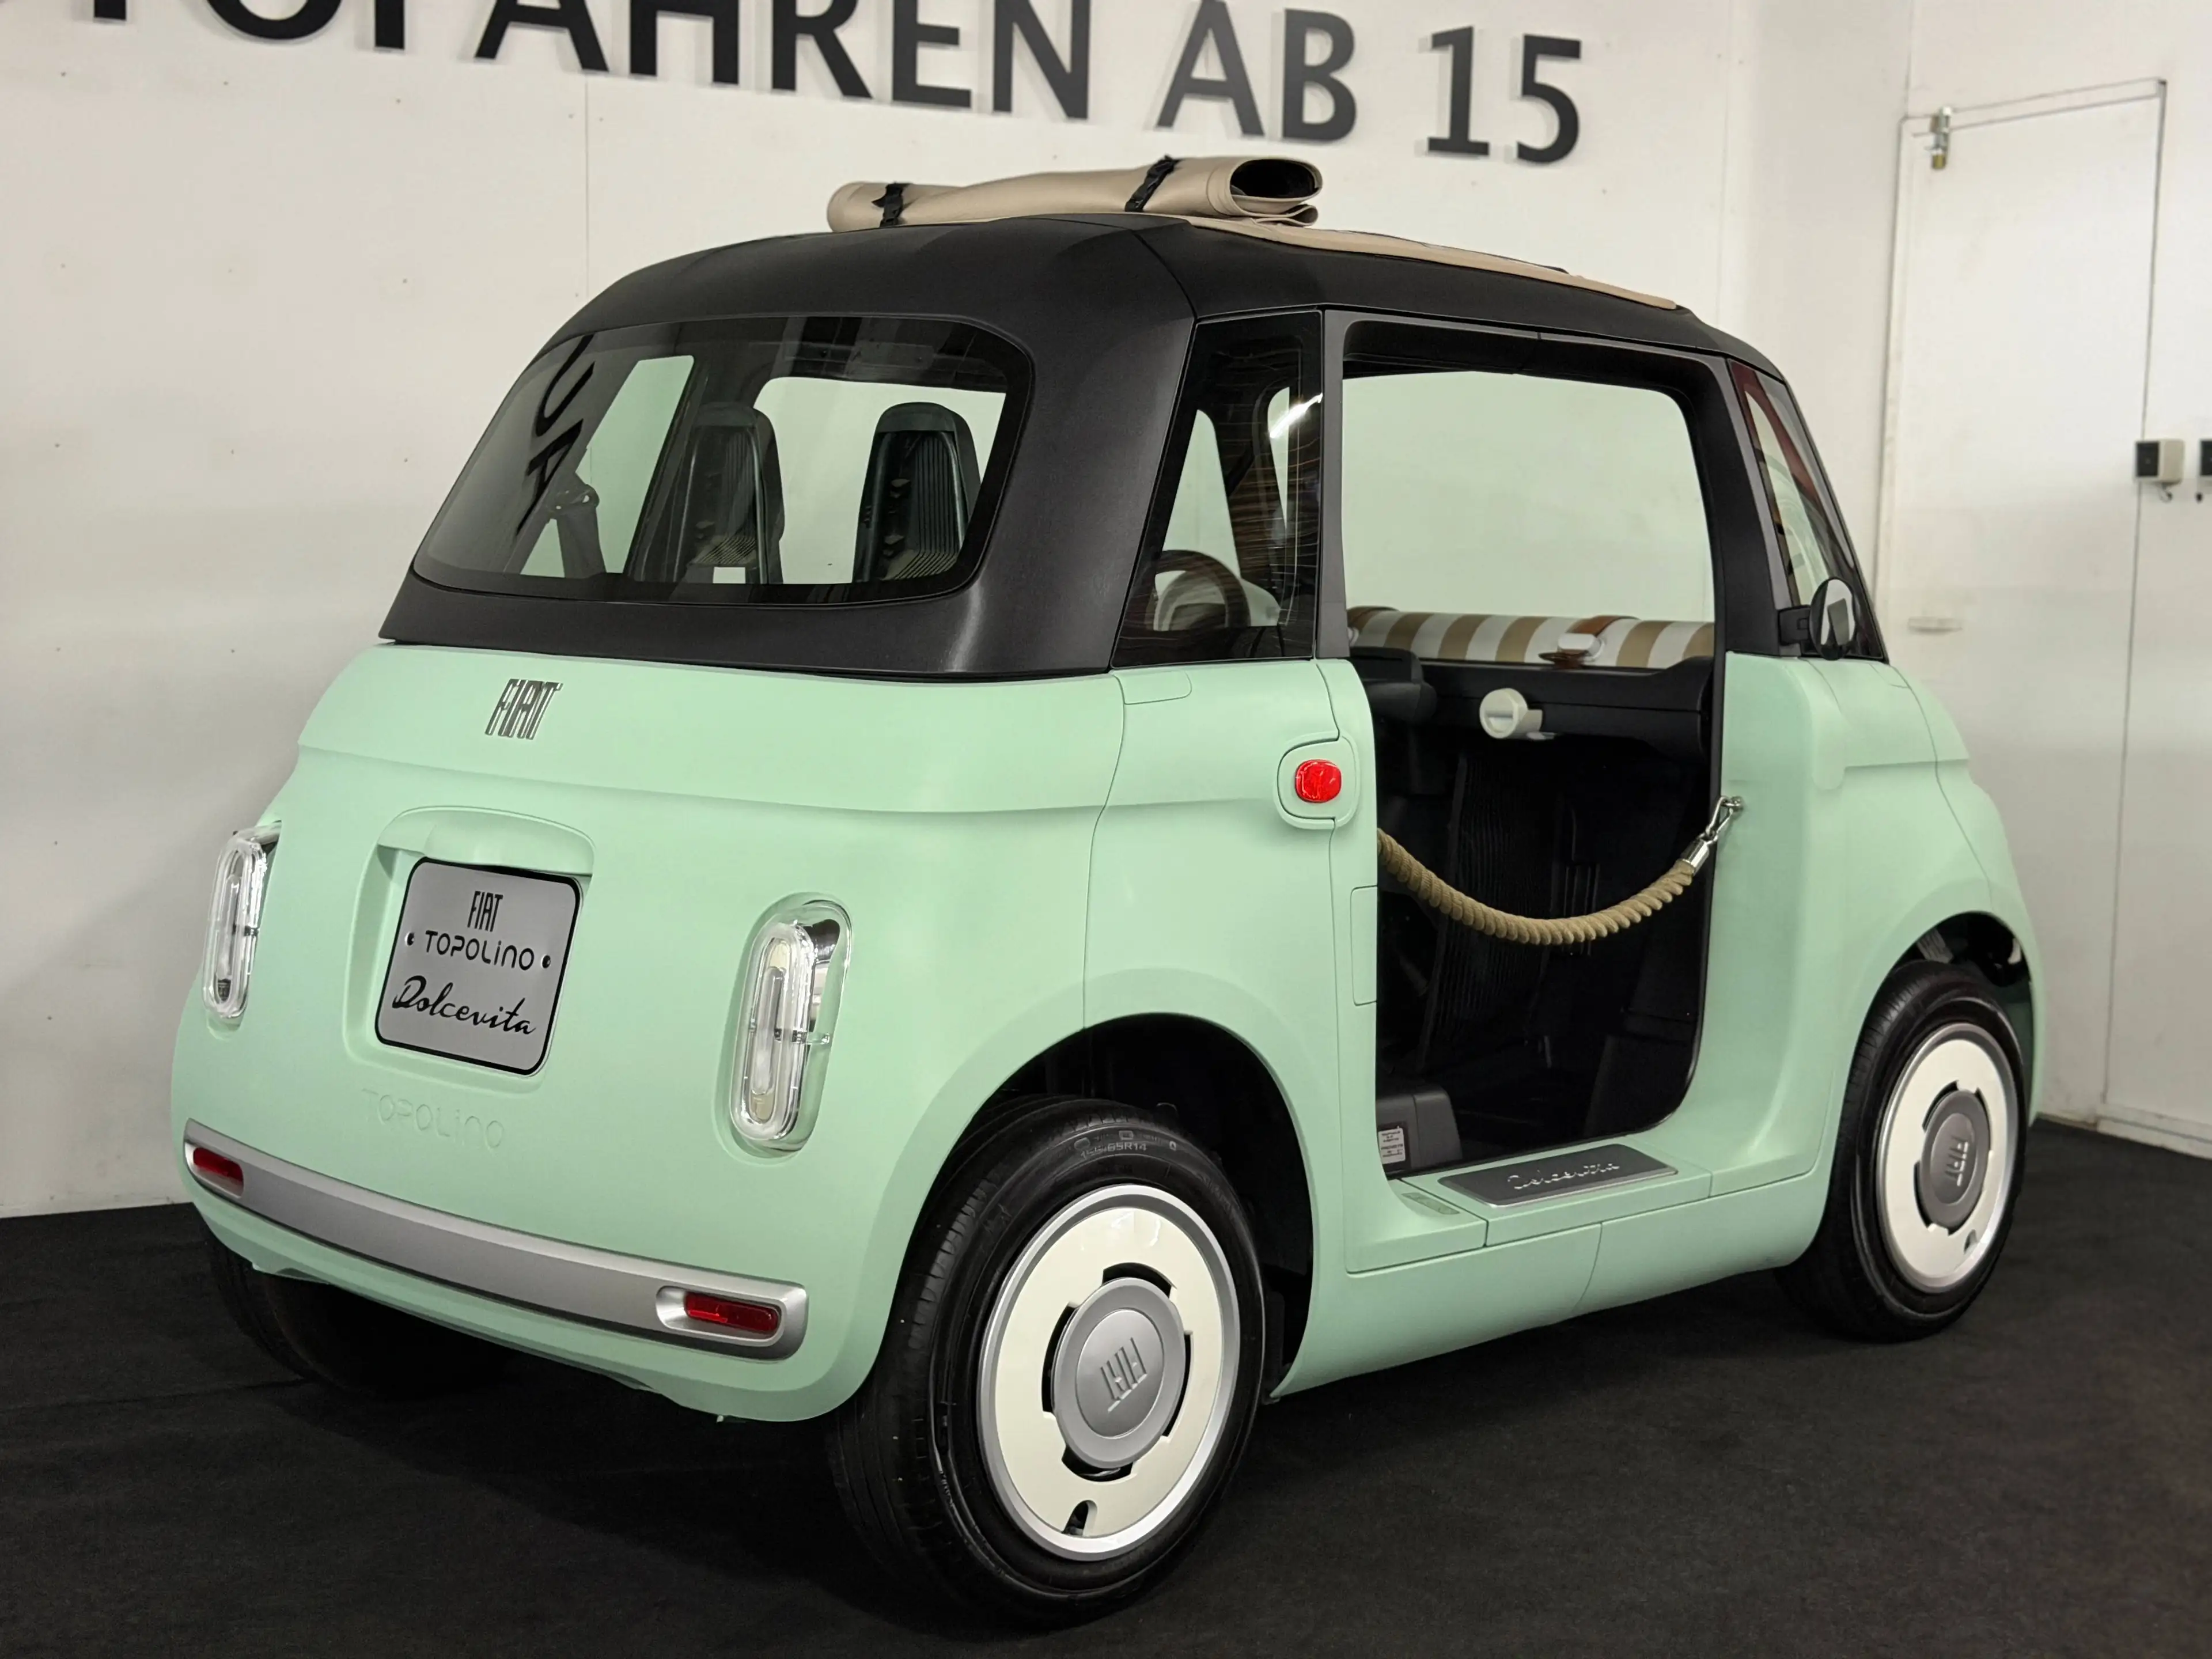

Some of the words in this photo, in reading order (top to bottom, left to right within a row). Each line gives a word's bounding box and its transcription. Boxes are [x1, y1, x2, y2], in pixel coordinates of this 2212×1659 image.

[1156, 0, 1357, 142] AB
[1427, 26, 1582, 164] 15
[484, 679, 563, 740] FIAT
[467, 891, 503, 932] FIAT
[392, 975, 536, 1035] Dolcevita
